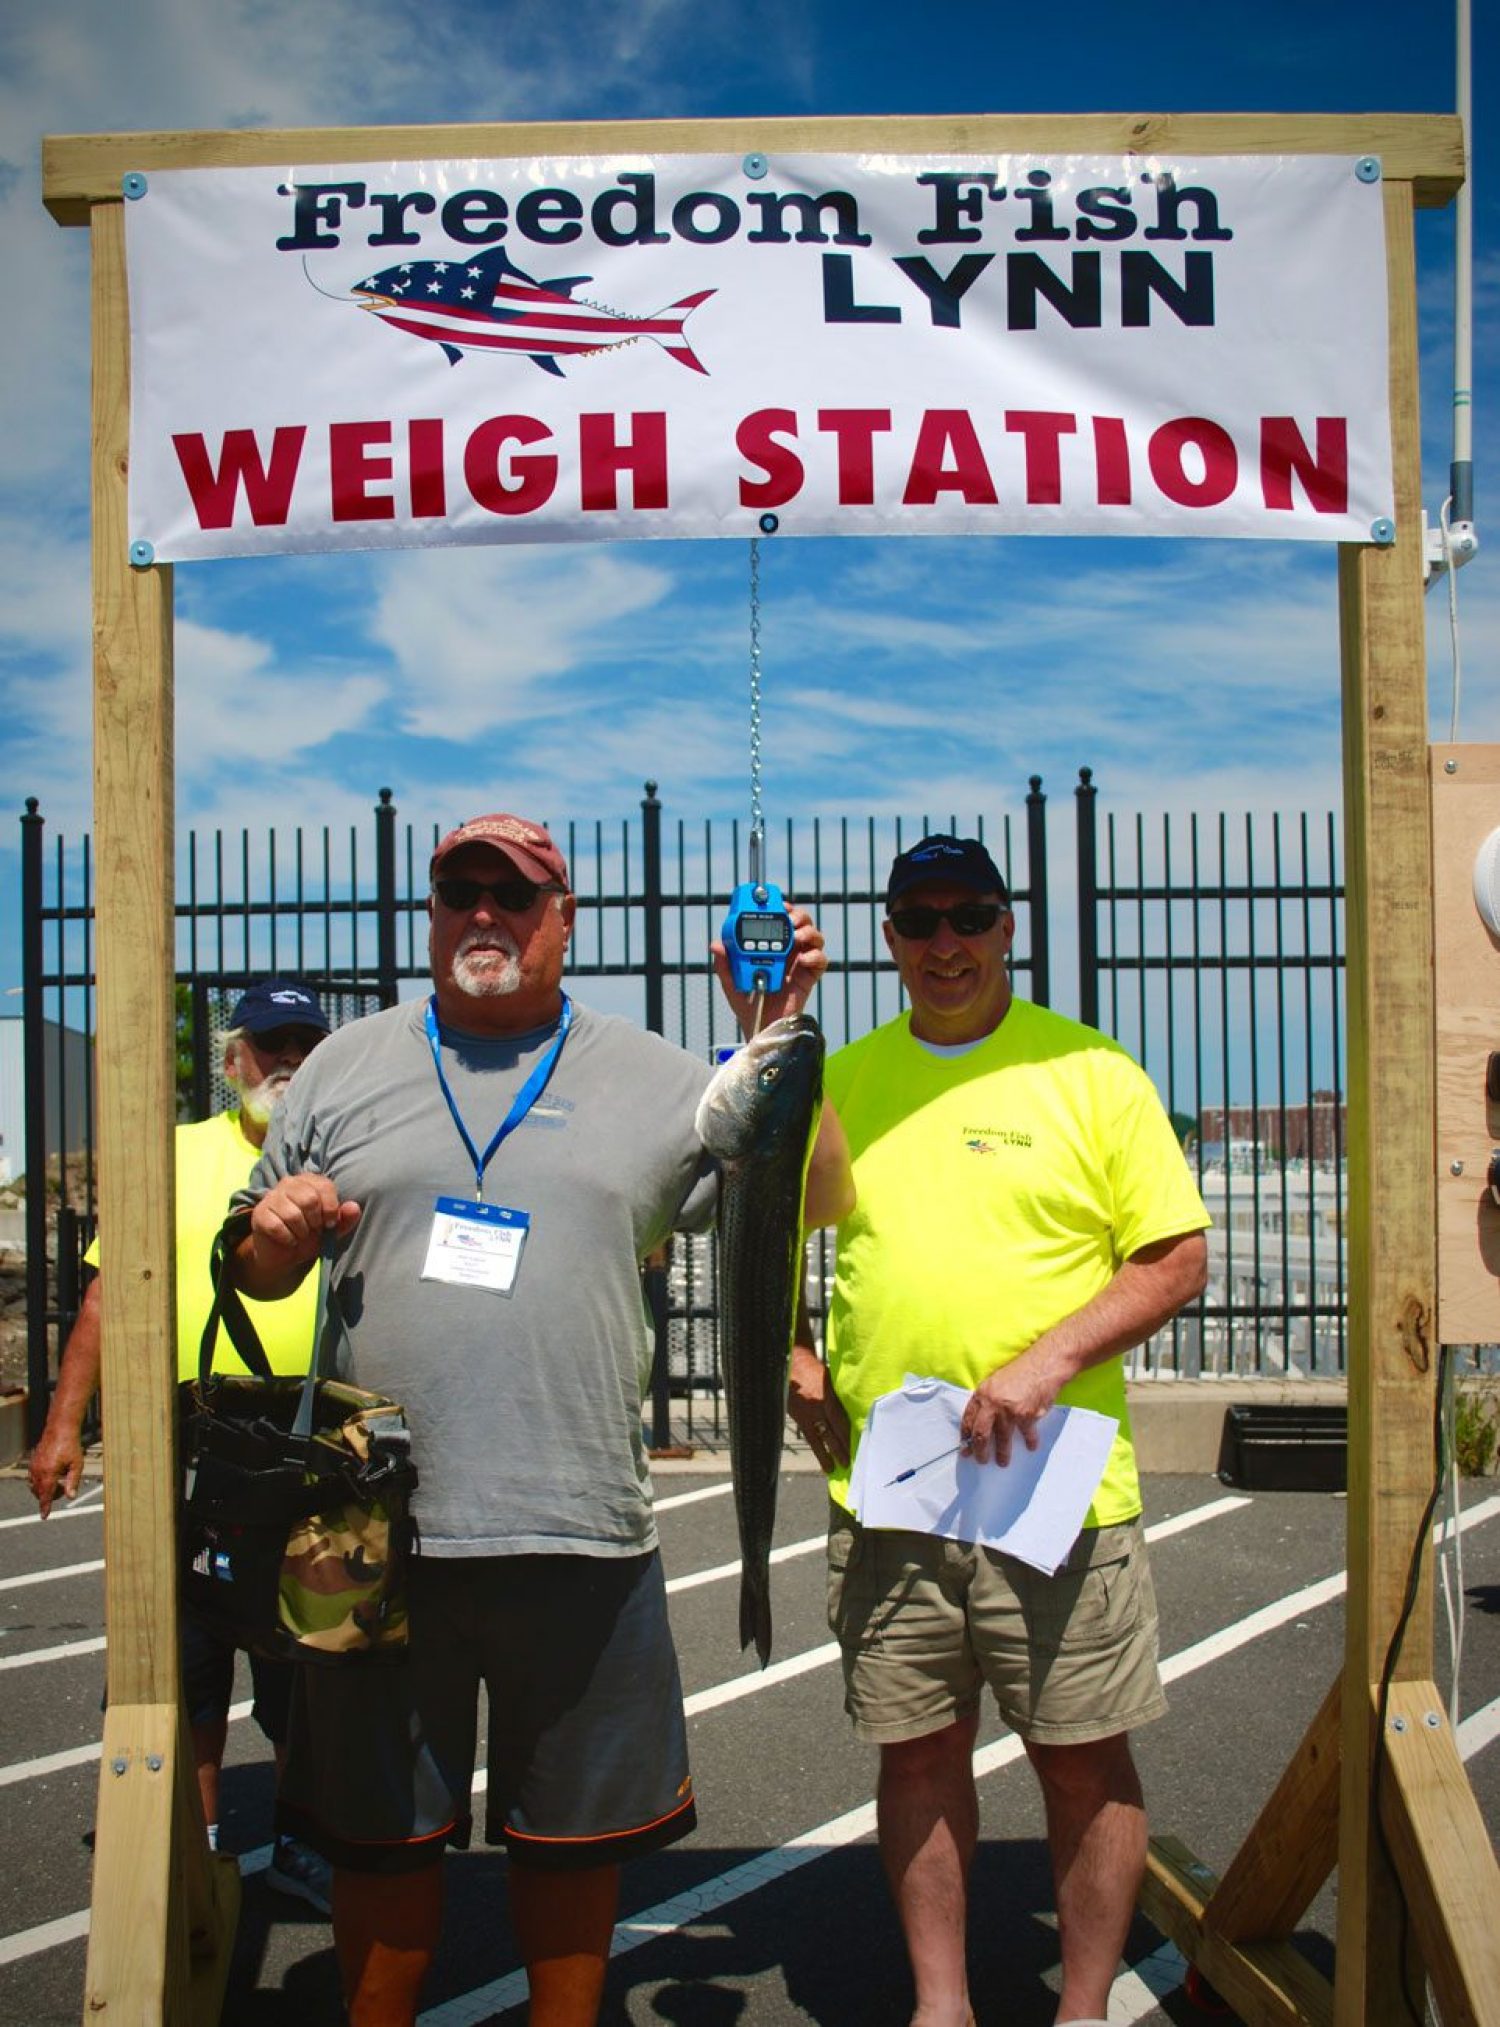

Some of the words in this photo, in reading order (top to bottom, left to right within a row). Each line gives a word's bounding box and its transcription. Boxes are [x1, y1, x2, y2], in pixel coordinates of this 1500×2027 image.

[276, 173, 872, 251] Freedom
[916, 170, 1233, 245] Fish
[822, 251, 1215, 330] LYNN
[172, 411, 669, 530] WEIGH
[735, 408, 1348, 514] STATION
